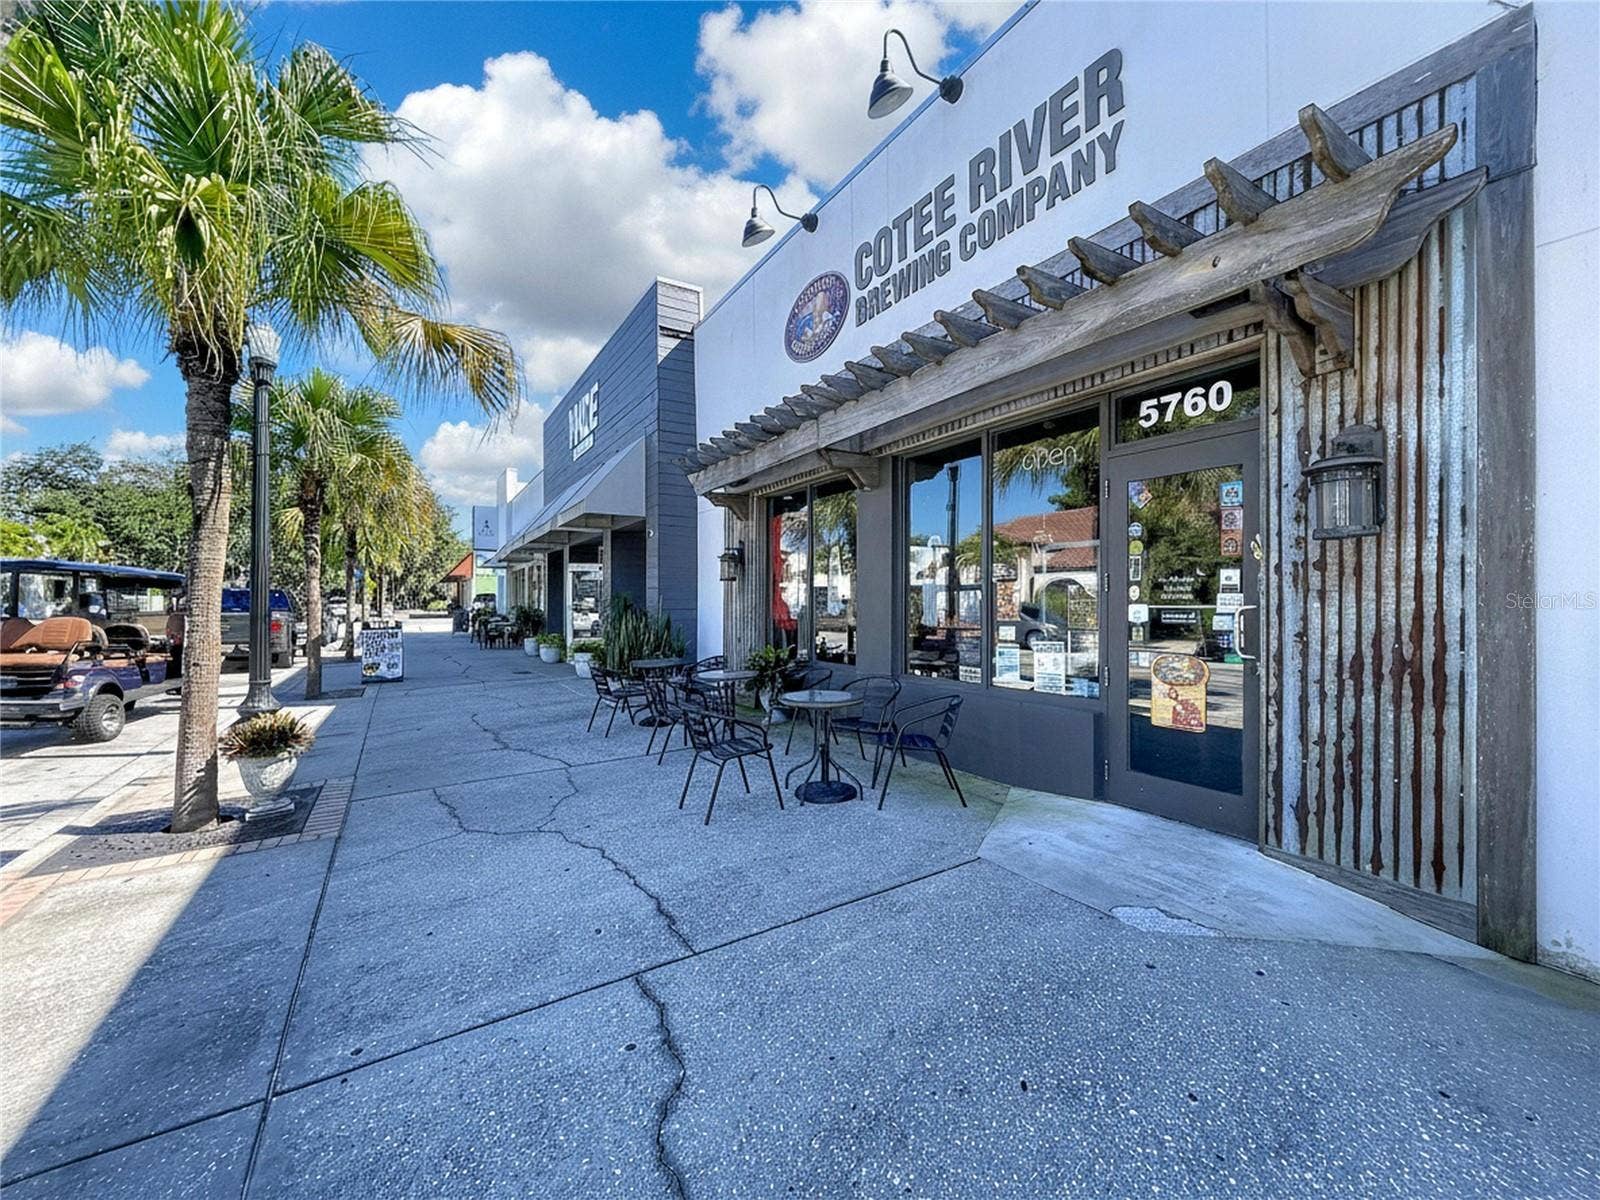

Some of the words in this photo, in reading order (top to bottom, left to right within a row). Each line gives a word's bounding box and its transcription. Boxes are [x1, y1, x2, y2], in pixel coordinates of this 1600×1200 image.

[854, 174, 956, 290] COTEE
[969, 48, 1126, 213] RIVER
[855, 239, 951, 328] BREWING
[959, 119, 1125, 262] COMPANY
[1138, 380, 1233, 429] 5760
